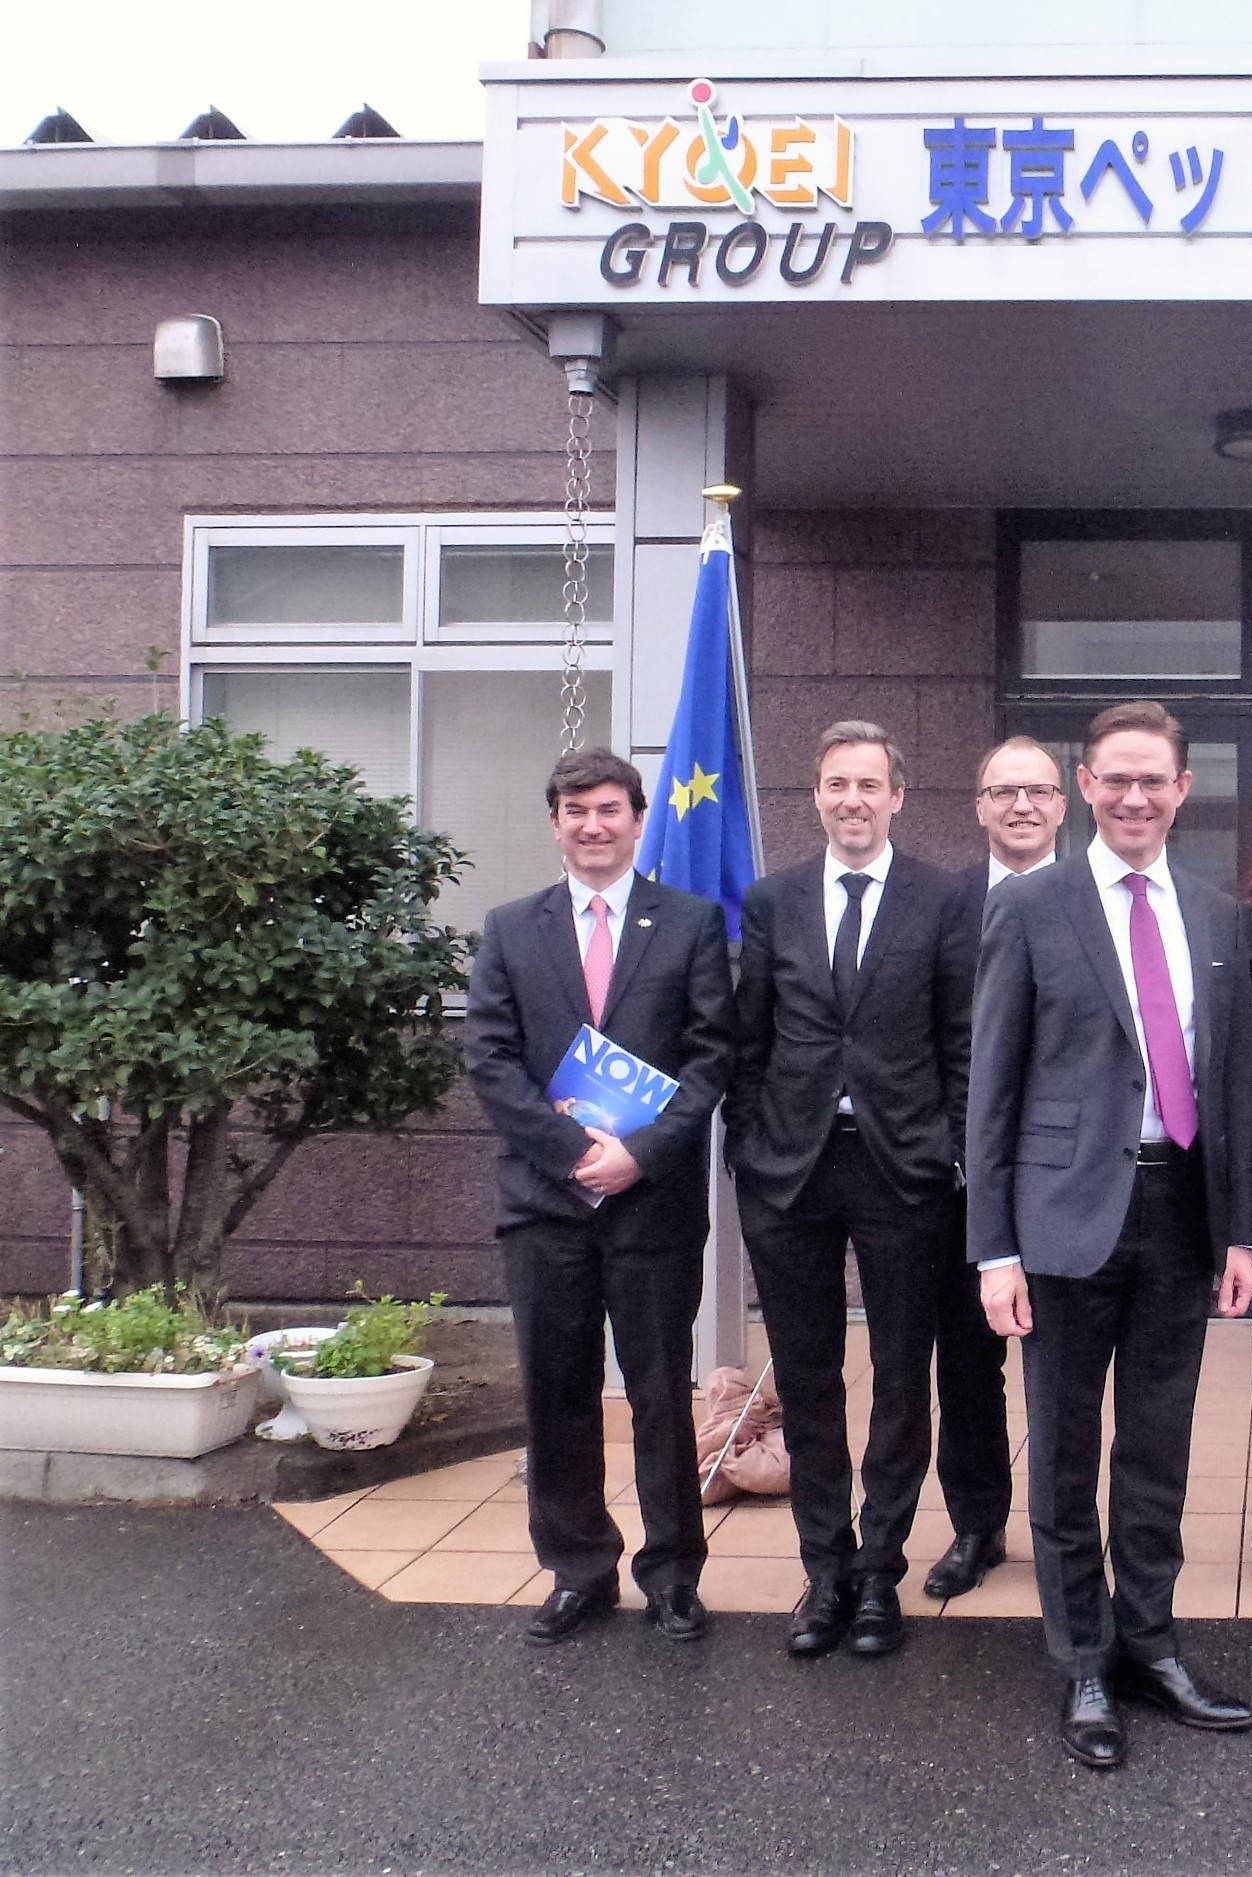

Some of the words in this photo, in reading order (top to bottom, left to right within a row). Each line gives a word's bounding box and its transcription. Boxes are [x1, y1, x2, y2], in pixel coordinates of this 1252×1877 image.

[561, 113, 855, 211] KYOEI
[599, 221, 893, 286] GROUP
[572, 1028, 679, 1113] NOW
